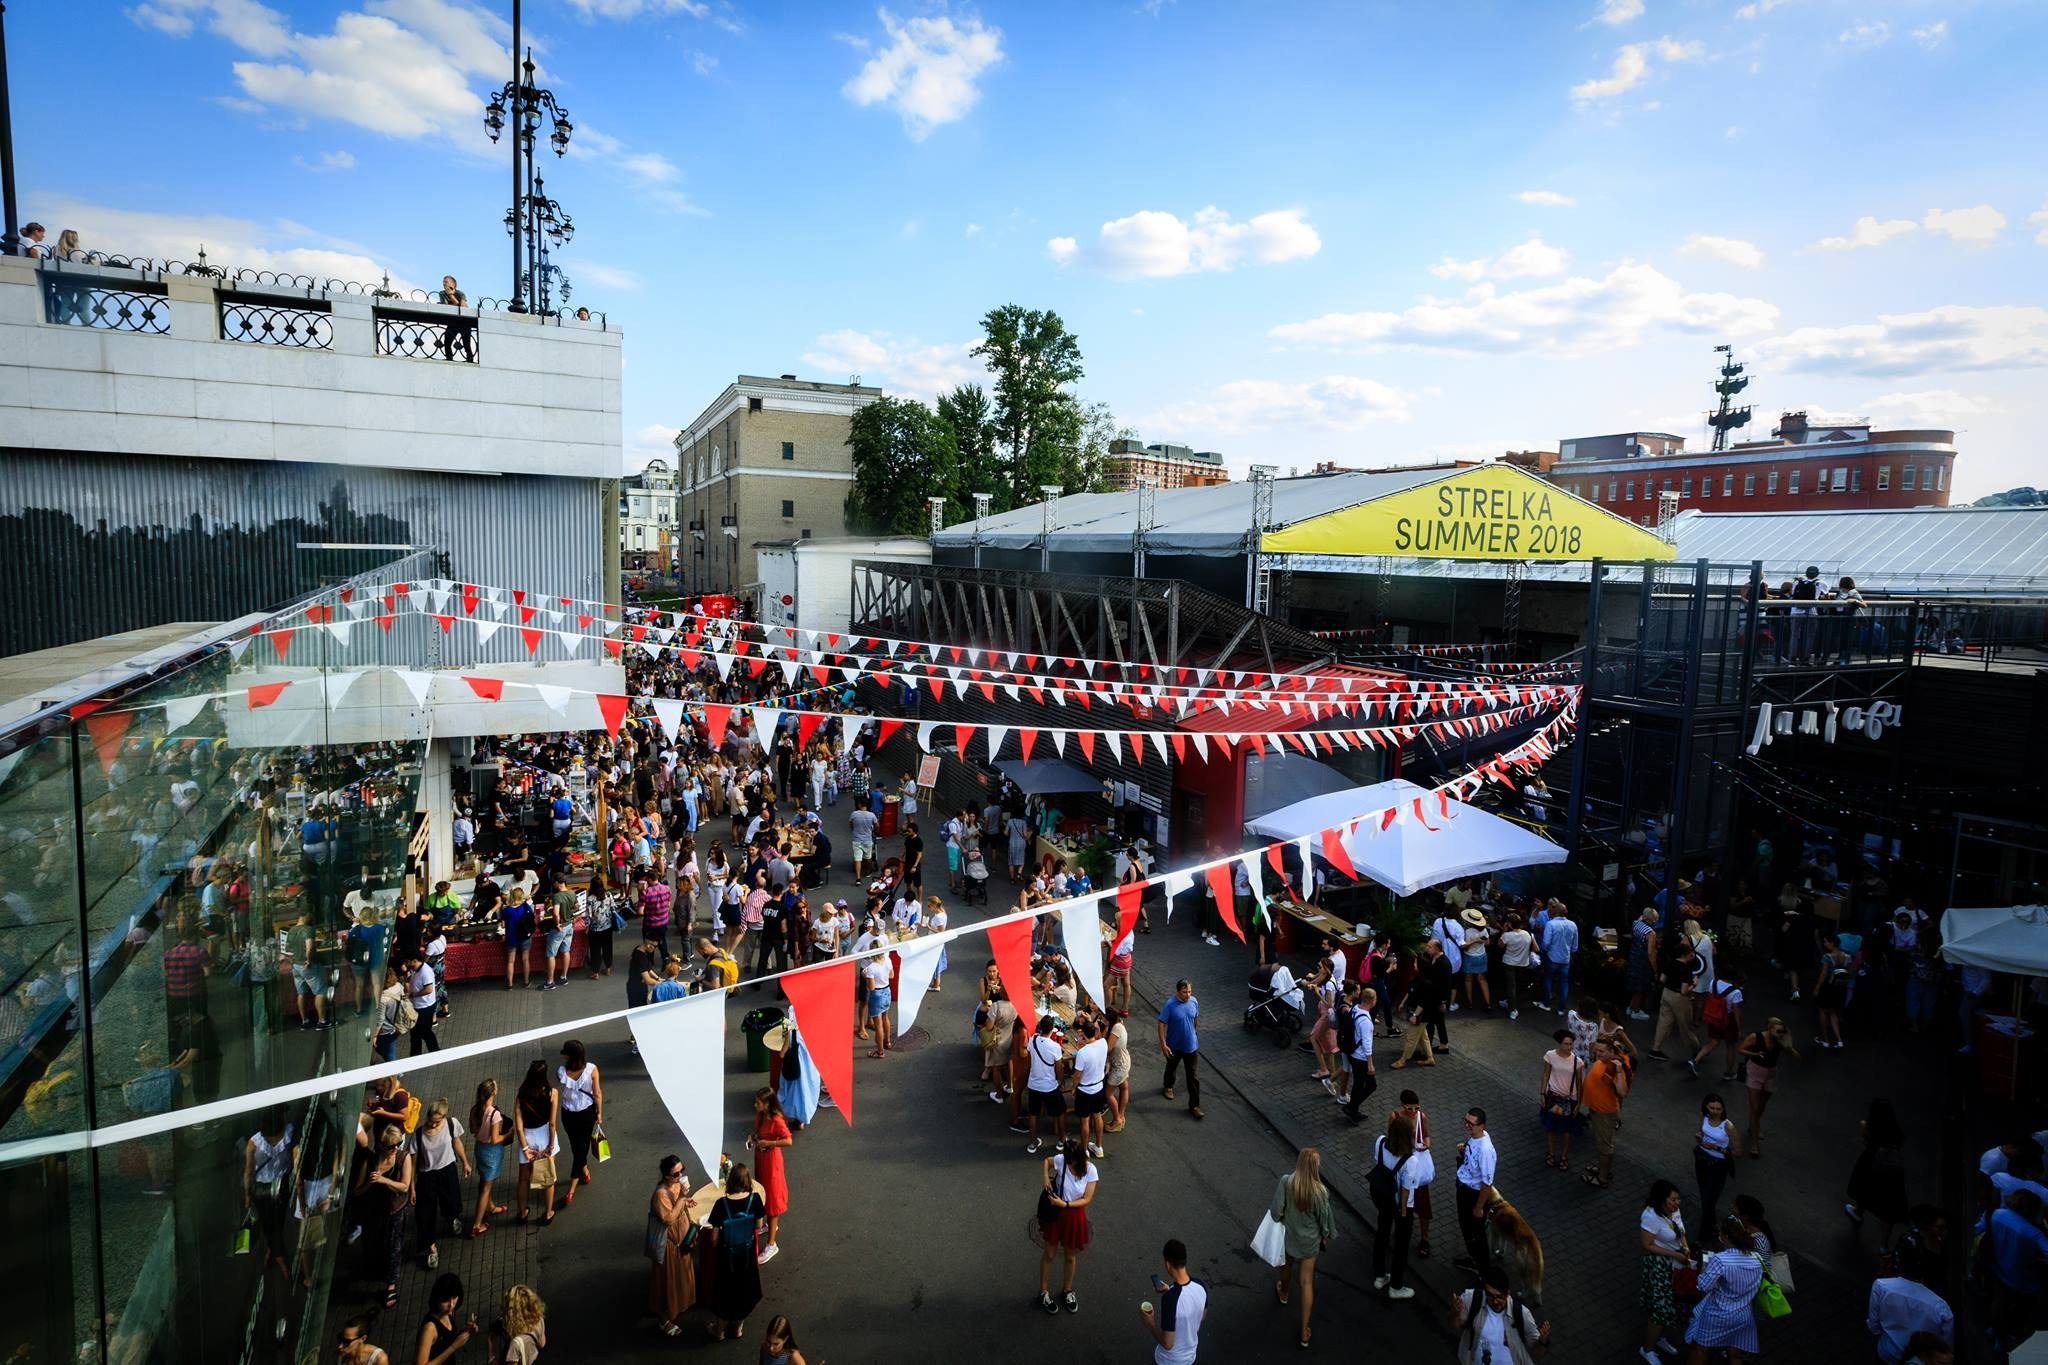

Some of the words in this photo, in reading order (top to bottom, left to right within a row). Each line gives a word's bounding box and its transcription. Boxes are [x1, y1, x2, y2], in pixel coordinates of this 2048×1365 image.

[1438, 486, 1552, 521] STRELKA
[1395, 518, 1520, 553] SUMMER
[1528, 525, 1581, 554] 2018
